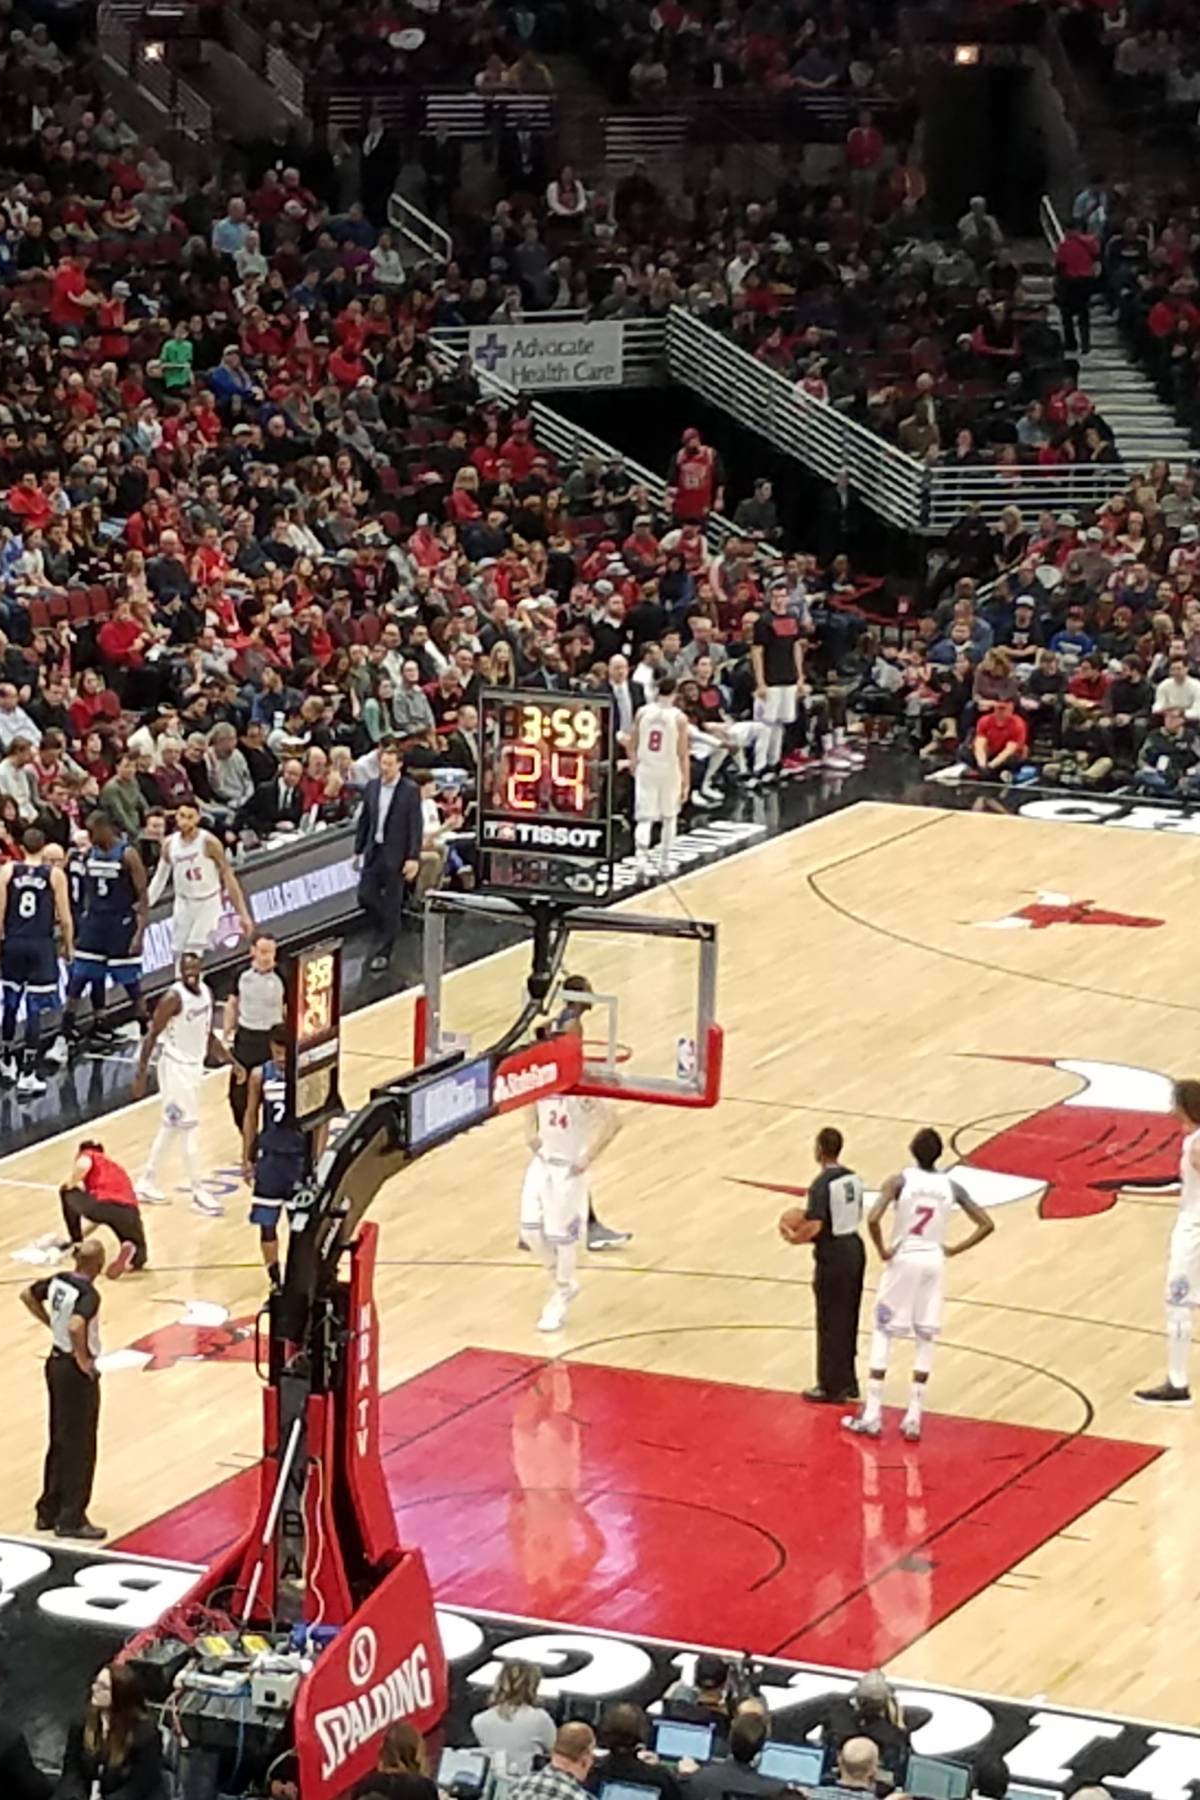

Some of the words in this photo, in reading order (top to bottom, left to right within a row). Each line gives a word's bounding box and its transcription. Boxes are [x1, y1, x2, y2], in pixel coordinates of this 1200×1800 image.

[511, 336, 595, 359] Advocate
[511, 361, 569, 384] Health
[573, 361, 615, 382] Care
[521, 705, 596, 749] 3:59
[648, 729, 663, 751] 8
[506, 746, 585, 812] 24
[516, 823, 604, 849] TISSOT
[18, 890, 37, 918] 8
[548, 1110, 569, 1130] 24
[908, 1206, 935, 1236] 7
[356, 1303, 373, 1392] NBA
[355, 1398, 371, 1457] TV
[314, 1642, 434, 1782] SPALDING
